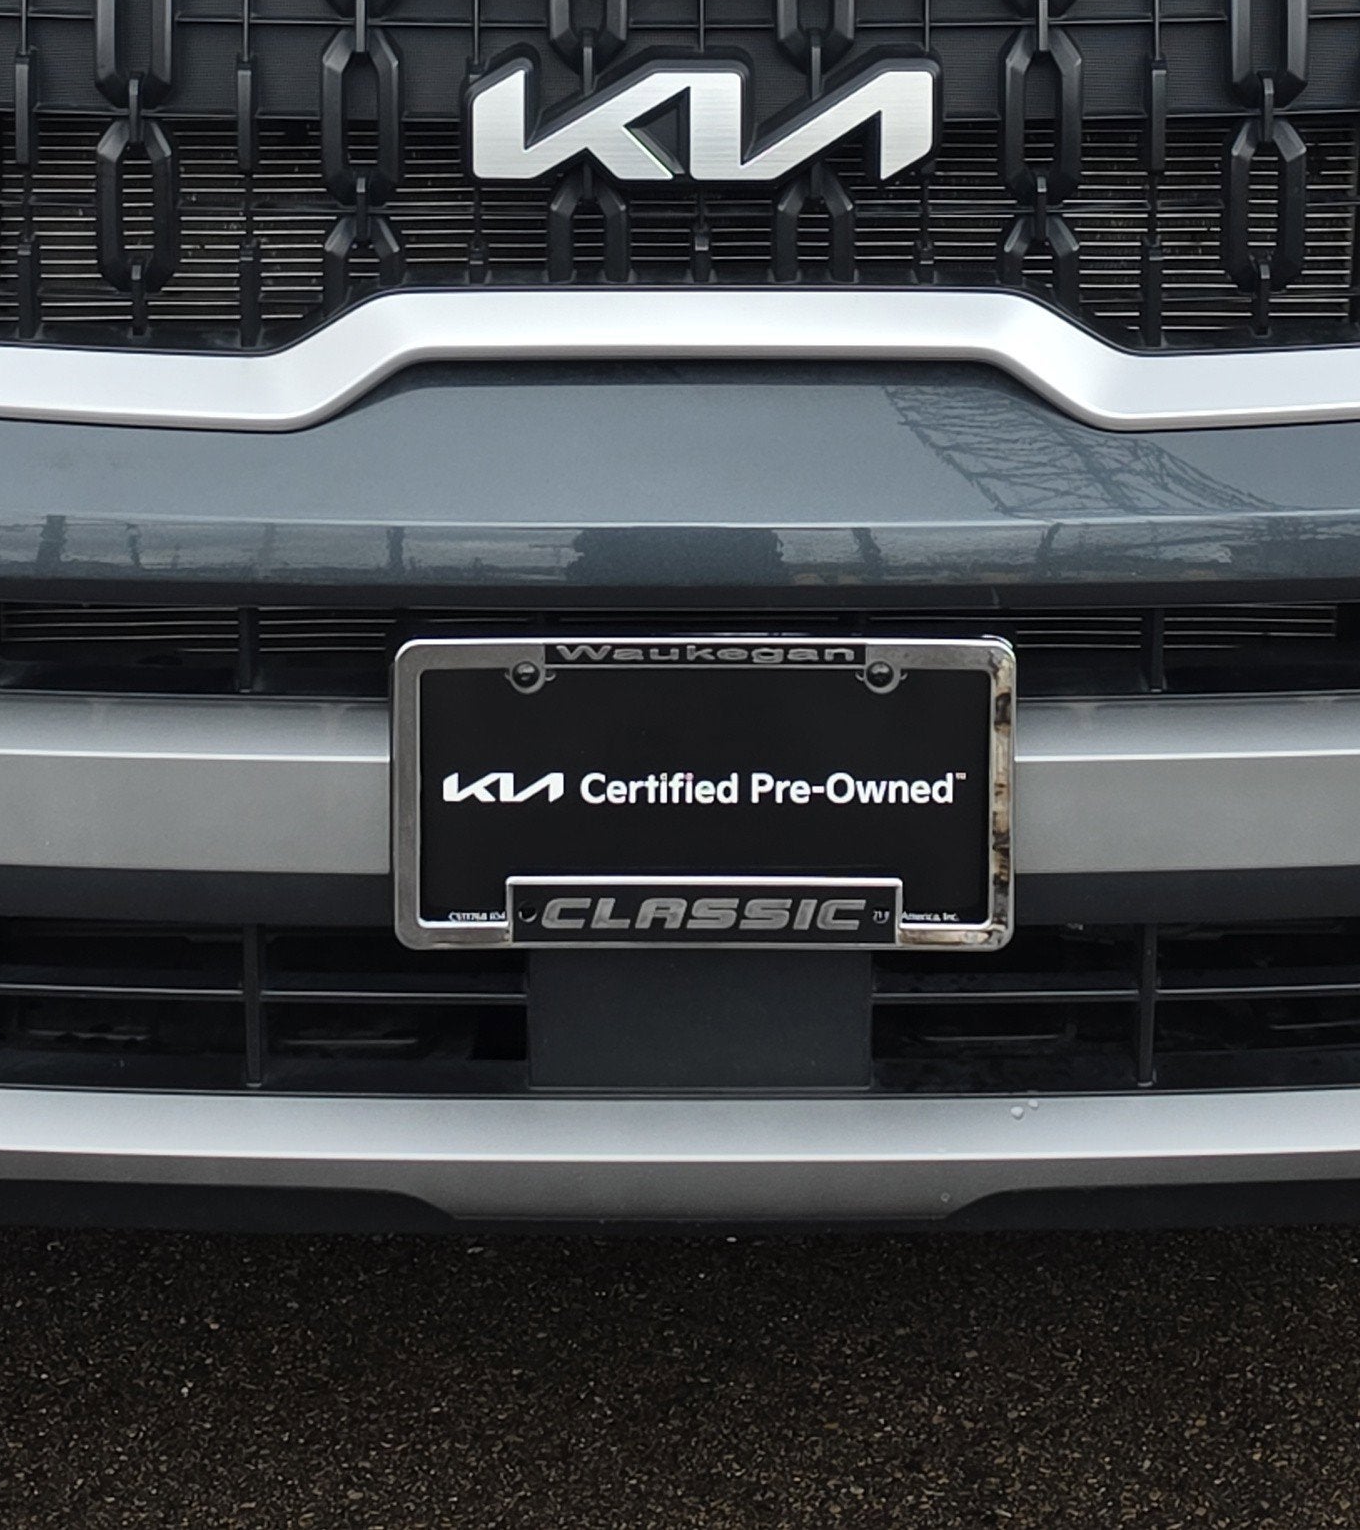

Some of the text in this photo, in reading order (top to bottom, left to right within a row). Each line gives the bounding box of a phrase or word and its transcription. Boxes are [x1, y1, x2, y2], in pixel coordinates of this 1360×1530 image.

[473, 69, 934, 180] KIA
[556, 645, 855, 663] Waukegan
[443, 772, 564, 802] KIA
[580, 772, 739, 804] Certified
[541, 897, 867, 930] CLASSIC
